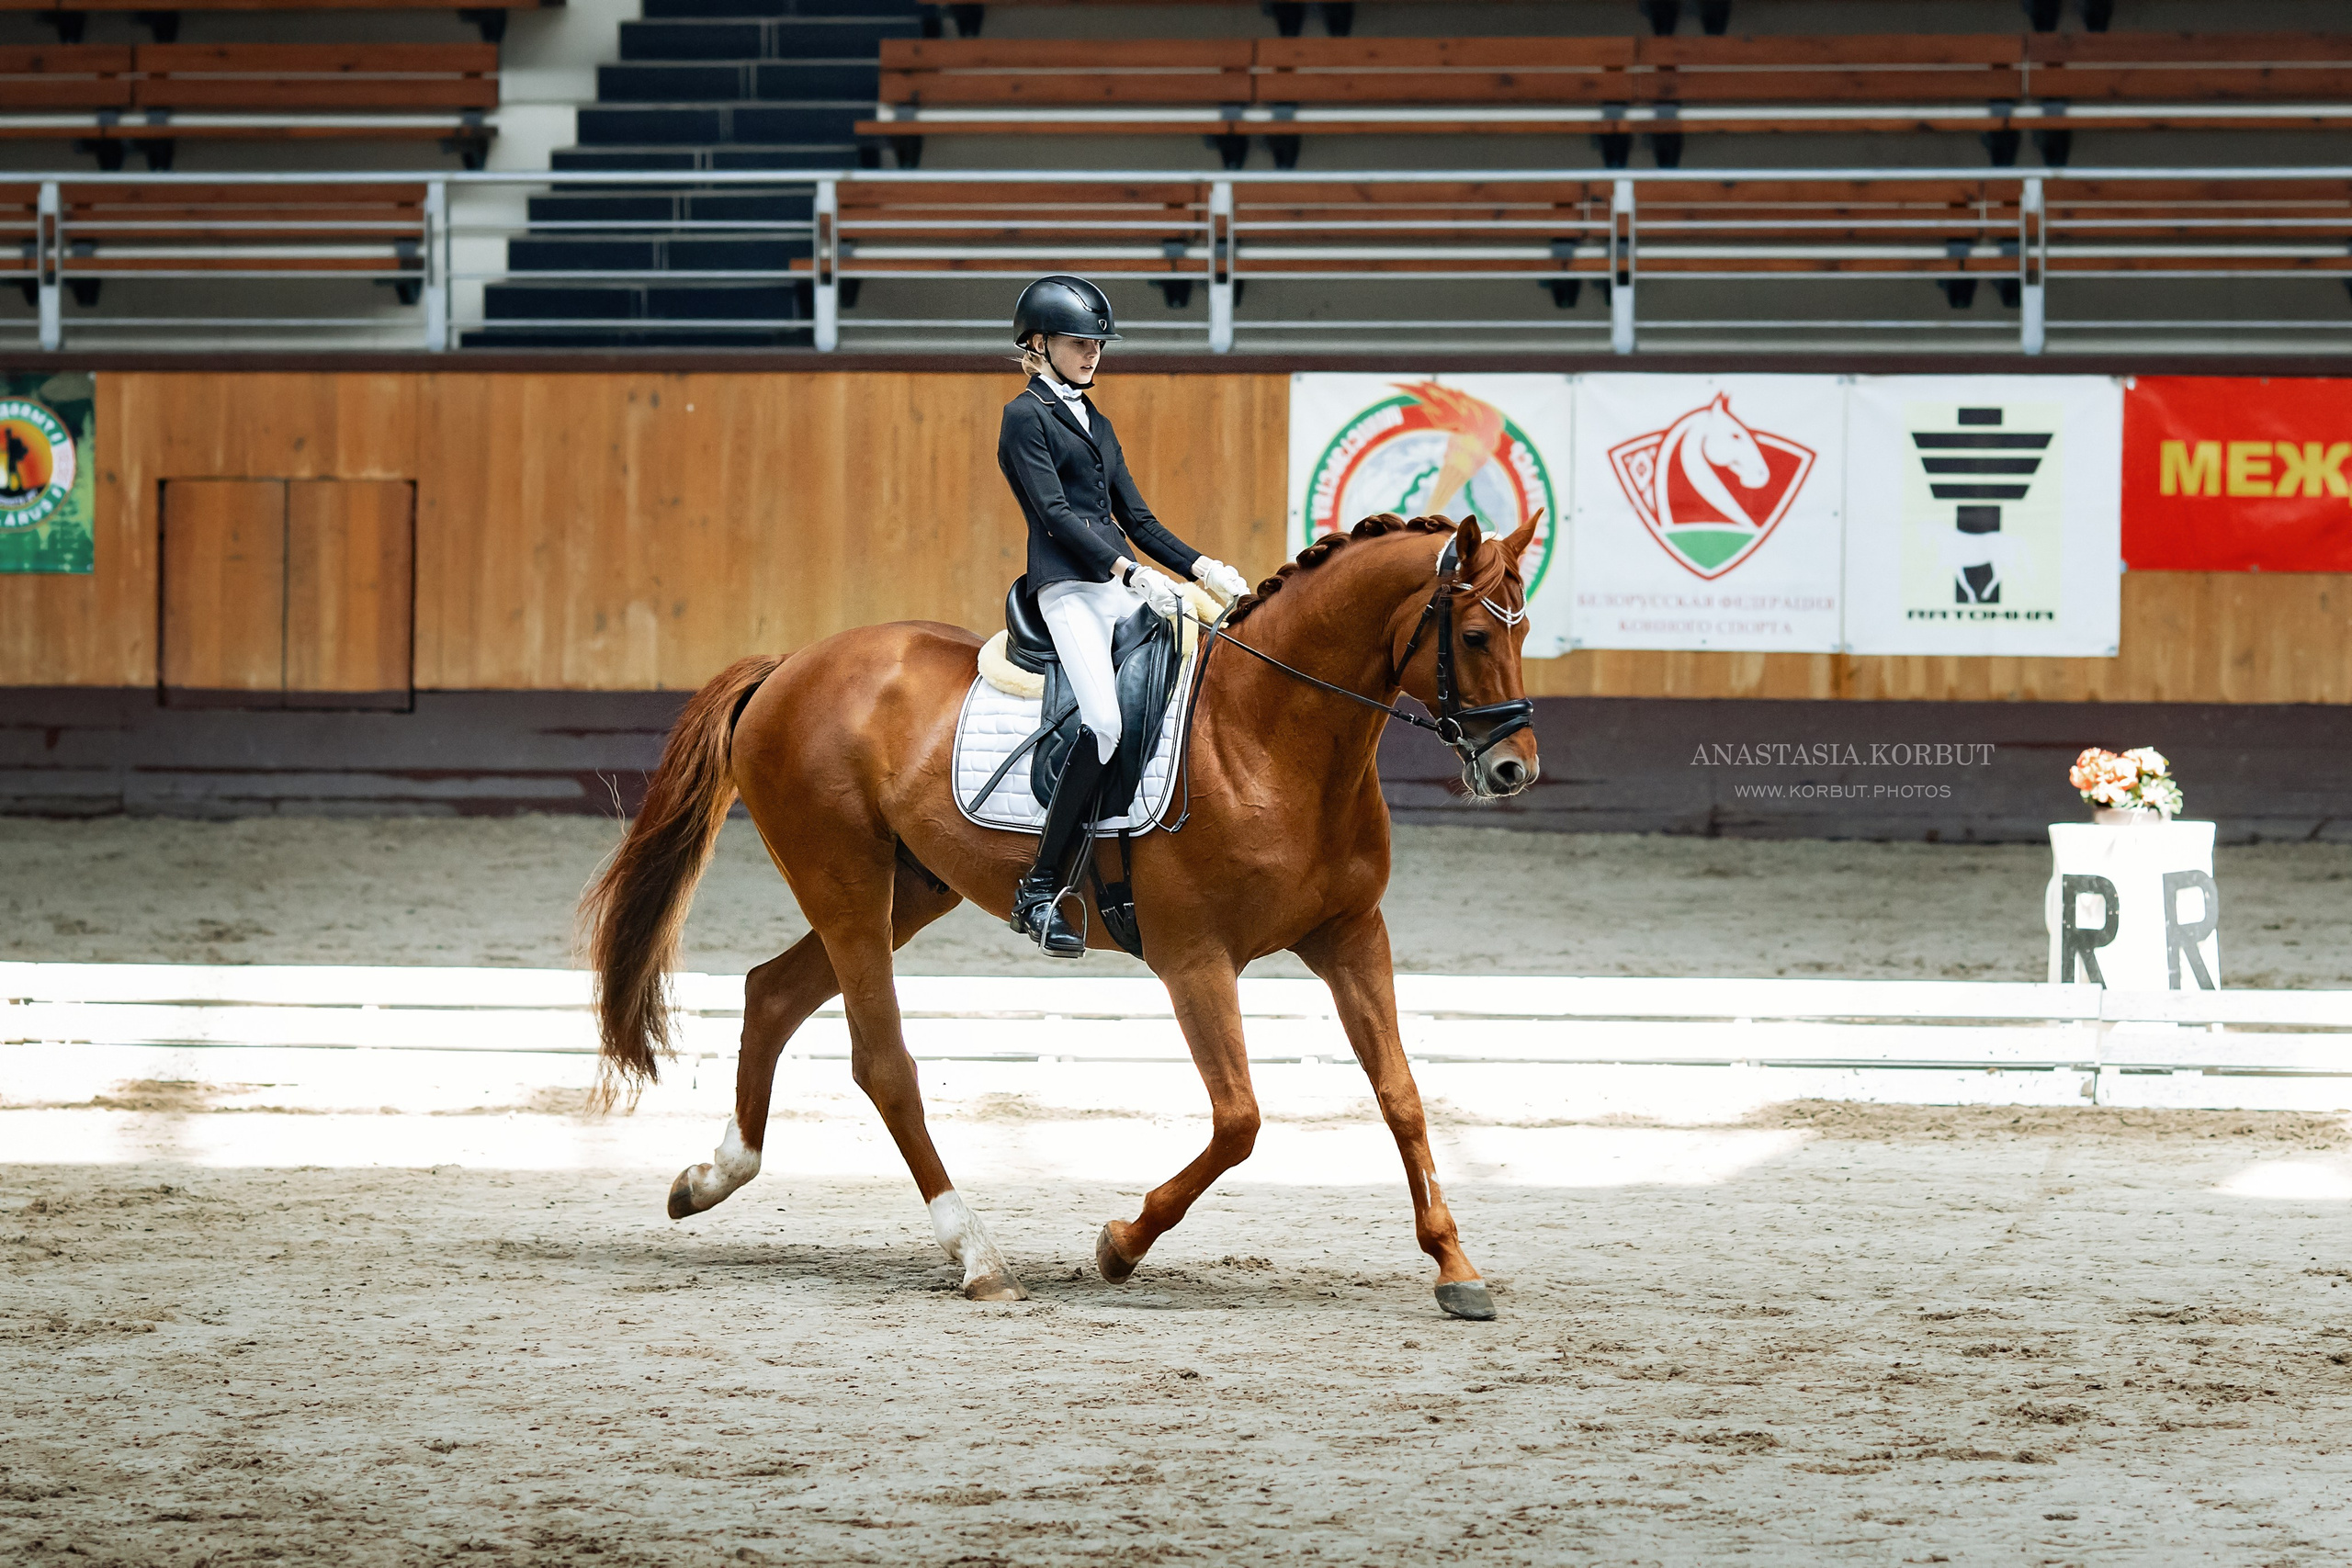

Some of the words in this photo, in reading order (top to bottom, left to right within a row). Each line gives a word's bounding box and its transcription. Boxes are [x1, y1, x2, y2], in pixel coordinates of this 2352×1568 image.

[2160, 440, 2352, 508] МЕЖ
[2061, 874, 2120, 990] R
[2163, 869, 2220, 990] R
